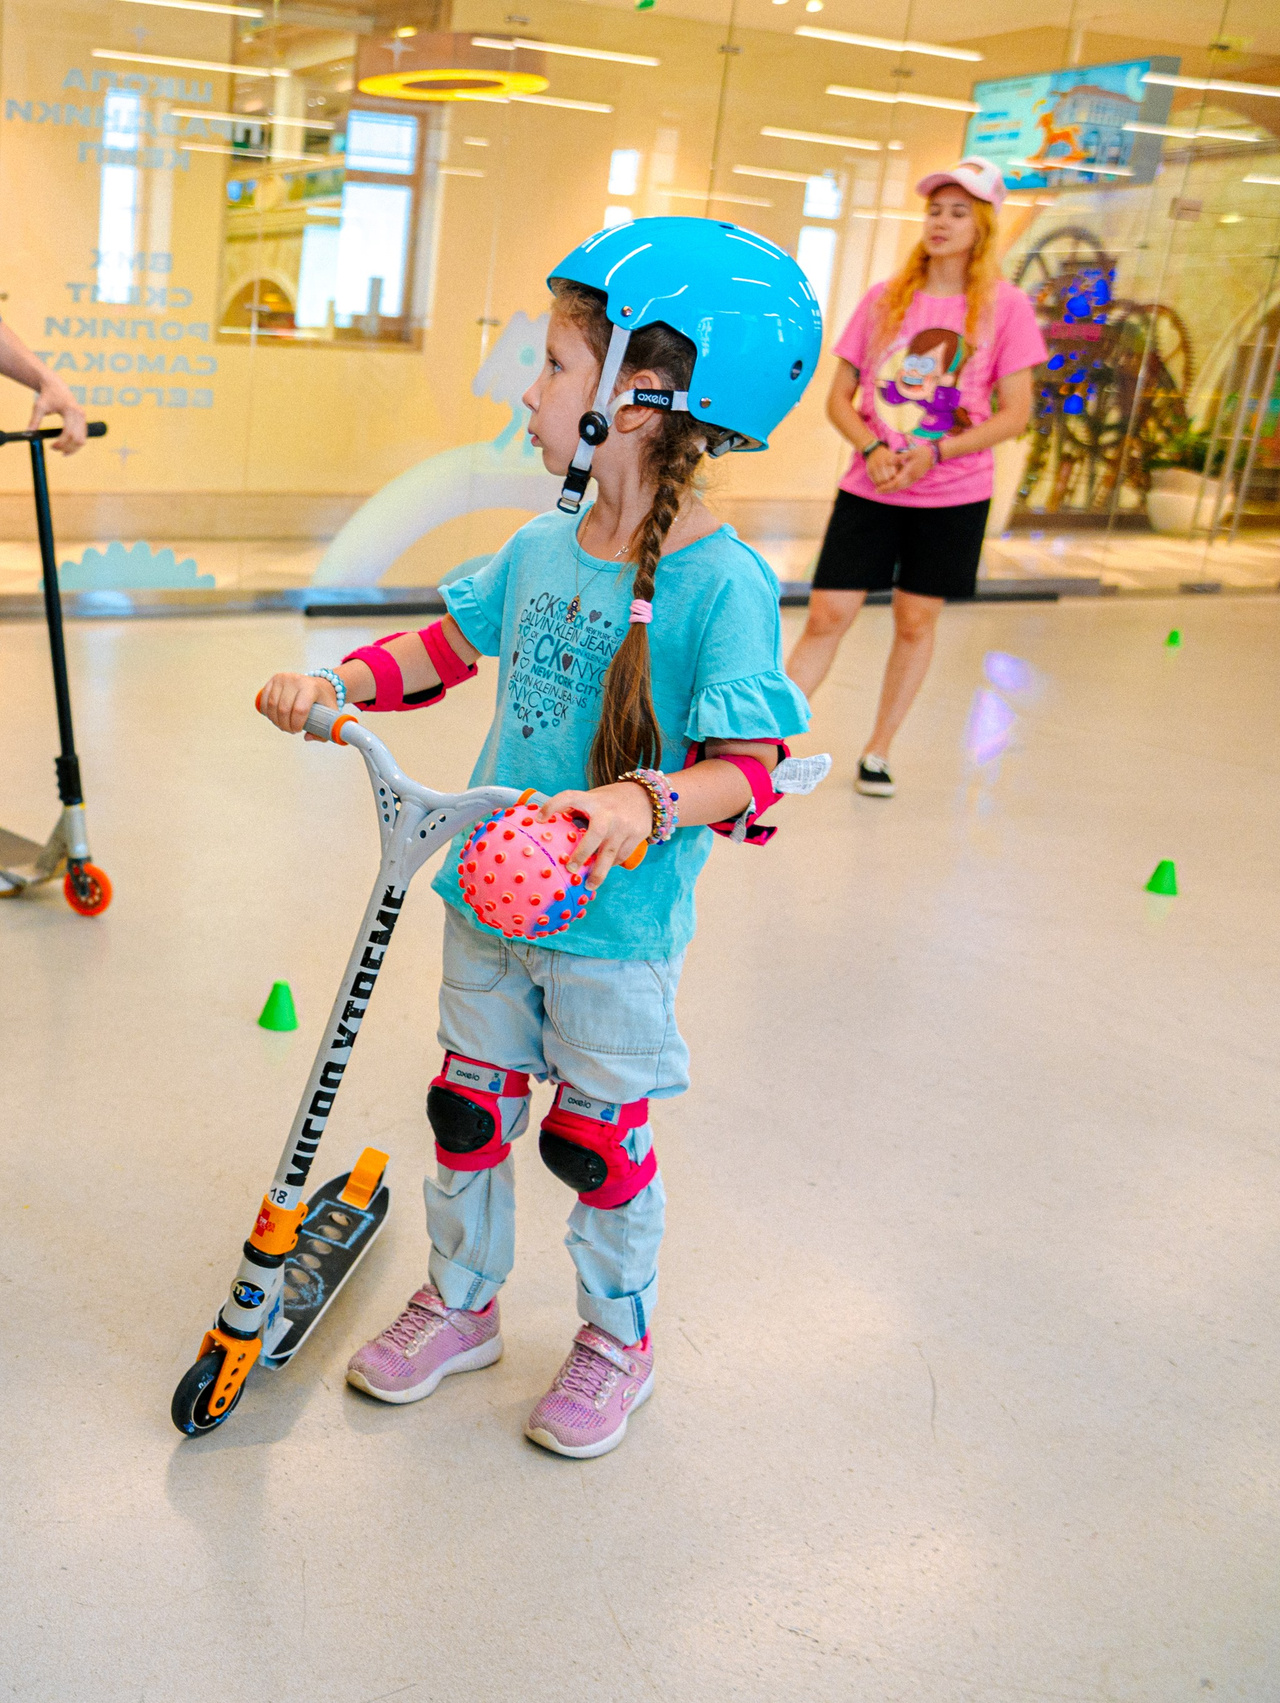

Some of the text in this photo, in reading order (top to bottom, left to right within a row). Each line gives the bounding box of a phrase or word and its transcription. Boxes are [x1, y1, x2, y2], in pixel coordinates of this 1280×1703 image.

[637, 393, 669, 406] oxelo
[535, 592, 562, 618] CK
[521, 608, 555, 634] CALVIN
[553, 621, 582, 643] KLEIN
[534, 634, 570, 672] CK
[531, 664, 602, 698] NEW YORK CITY
[517, 706, 532, 723] CK
[553, 701, 569, 720] CK
[455, 1068, 481, 1082] oxelo
[567, 1096, 592, 1110] oxelo
[270, 1187, 288, 1205] 18
